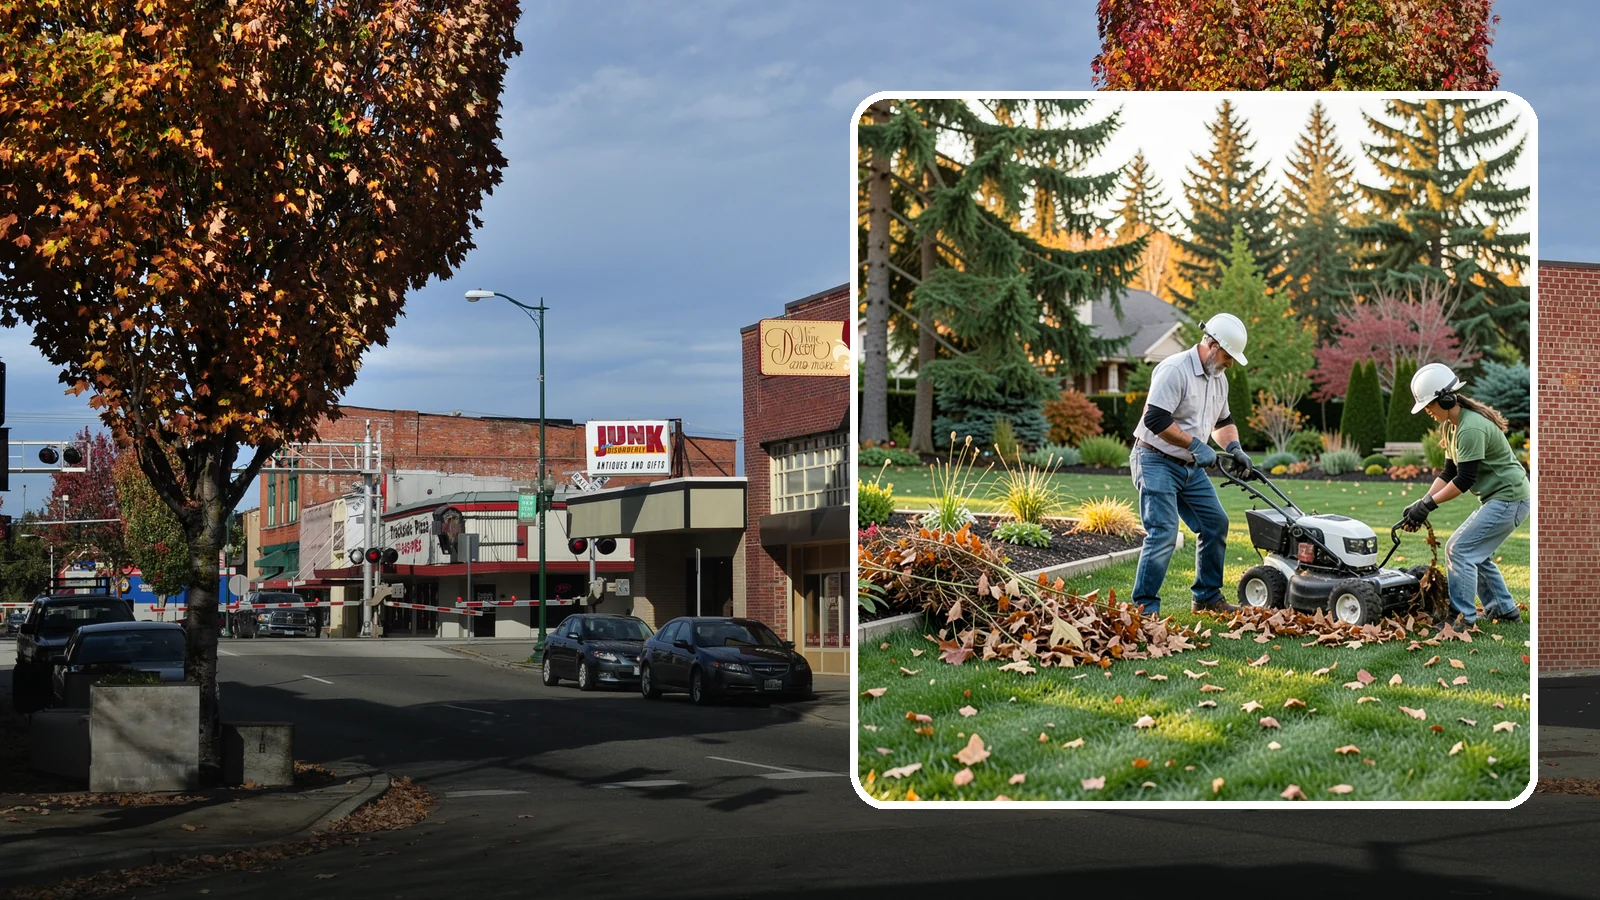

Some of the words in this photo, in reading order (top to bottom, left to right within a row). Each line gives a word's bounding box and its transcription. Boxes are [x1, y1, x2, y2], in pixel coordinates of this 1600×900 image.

[765, 327, 831, 366] Decor
[595, 425, 666, 457] JUNK
[607, 446, 646, 454] DISORDERLY
[596, 461, 628, 470] ANTIQUES
[631, 461, 644, 469] AND
[647, 460, 665, 469] GIFTS
[573, 473, 589, 492] RAIL
[590, 477, 608, 491] SING
[352, 499, 364, 511] CRO
[390, 522, 412, 539] Trackside
[414, 519, 429, 534] Pizza
